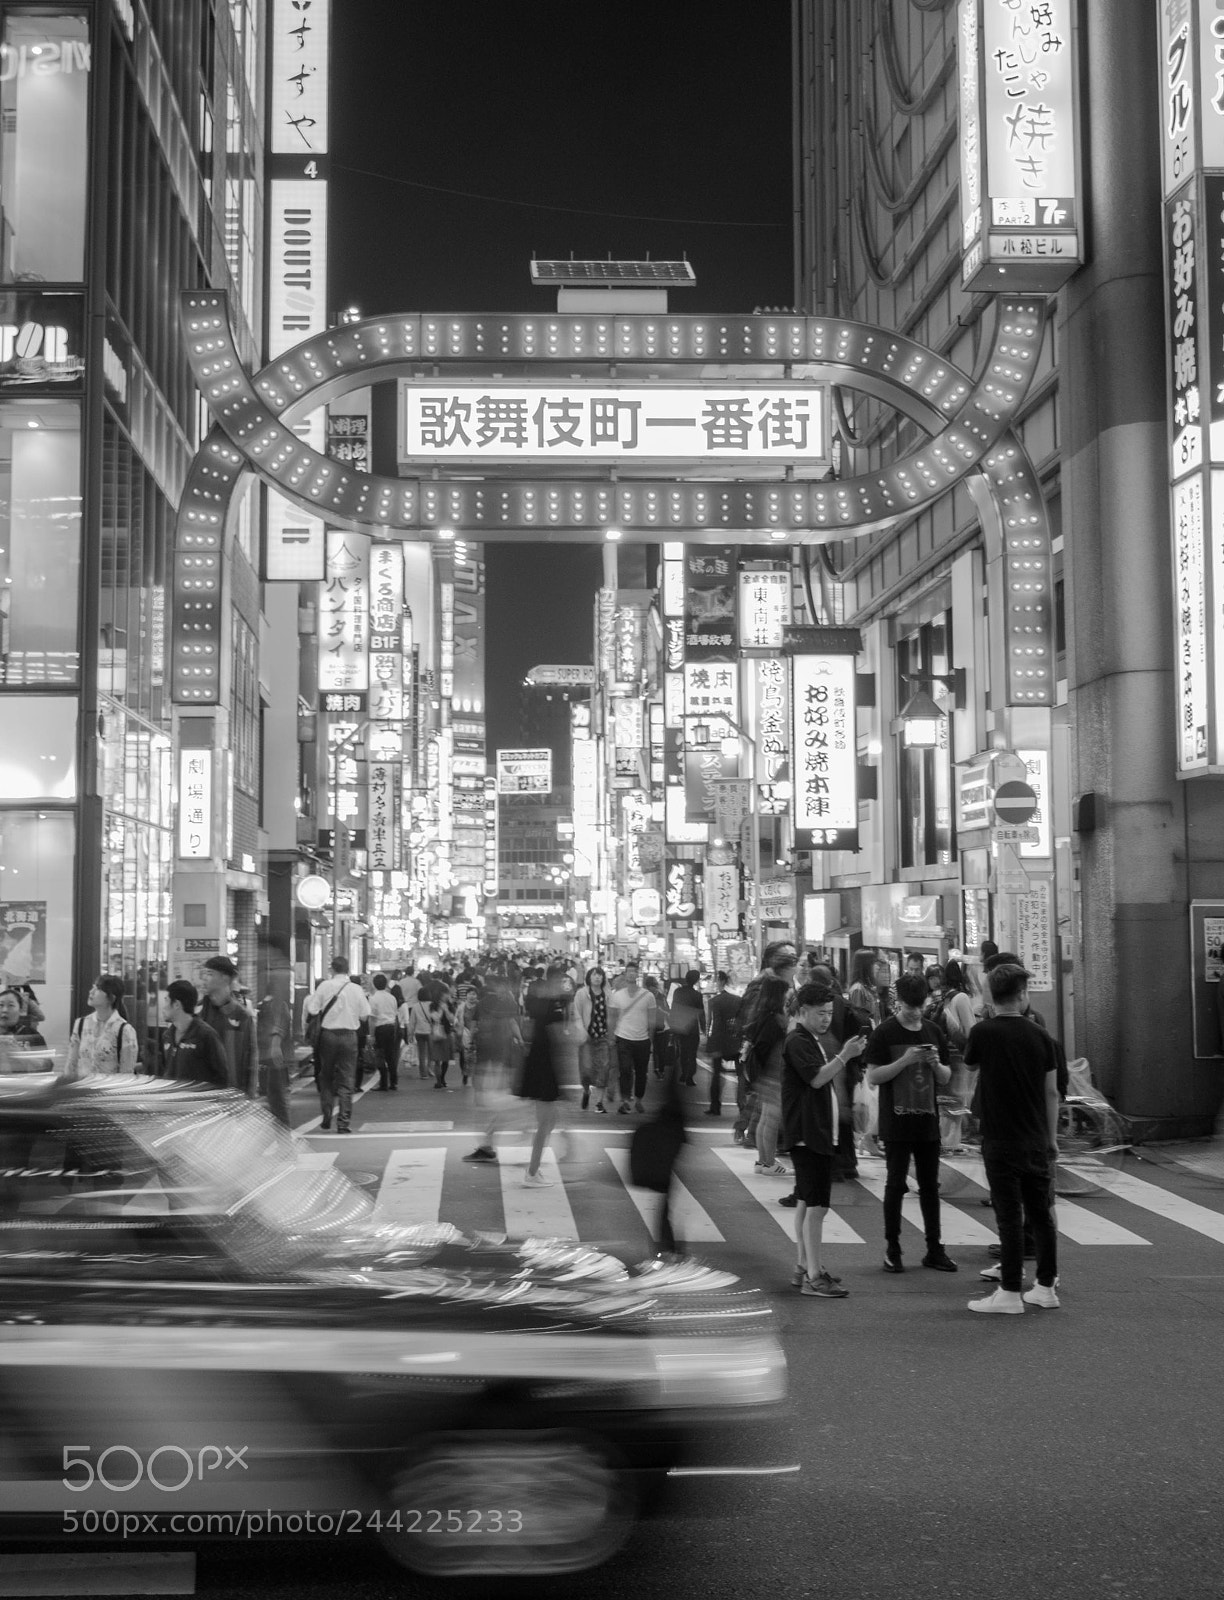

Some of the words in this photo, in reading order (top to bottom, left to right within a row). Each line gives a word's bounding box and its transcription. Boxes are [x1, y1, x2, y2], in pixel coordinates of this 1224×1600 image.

[304, 160, 318, 178] 4
[1038, 199, 1067, 225] 7F
[1003, 238, 1063, 255] 小松ビル
[281, 208, 316, 332] DOUTOR
[419, 395, 811, 450] 歌舞伎町一番街
[370, 636, 400, 650] B1F
[188, 759, 204, 849] 劇場通り
[811, 829, 838, 845] 2F
